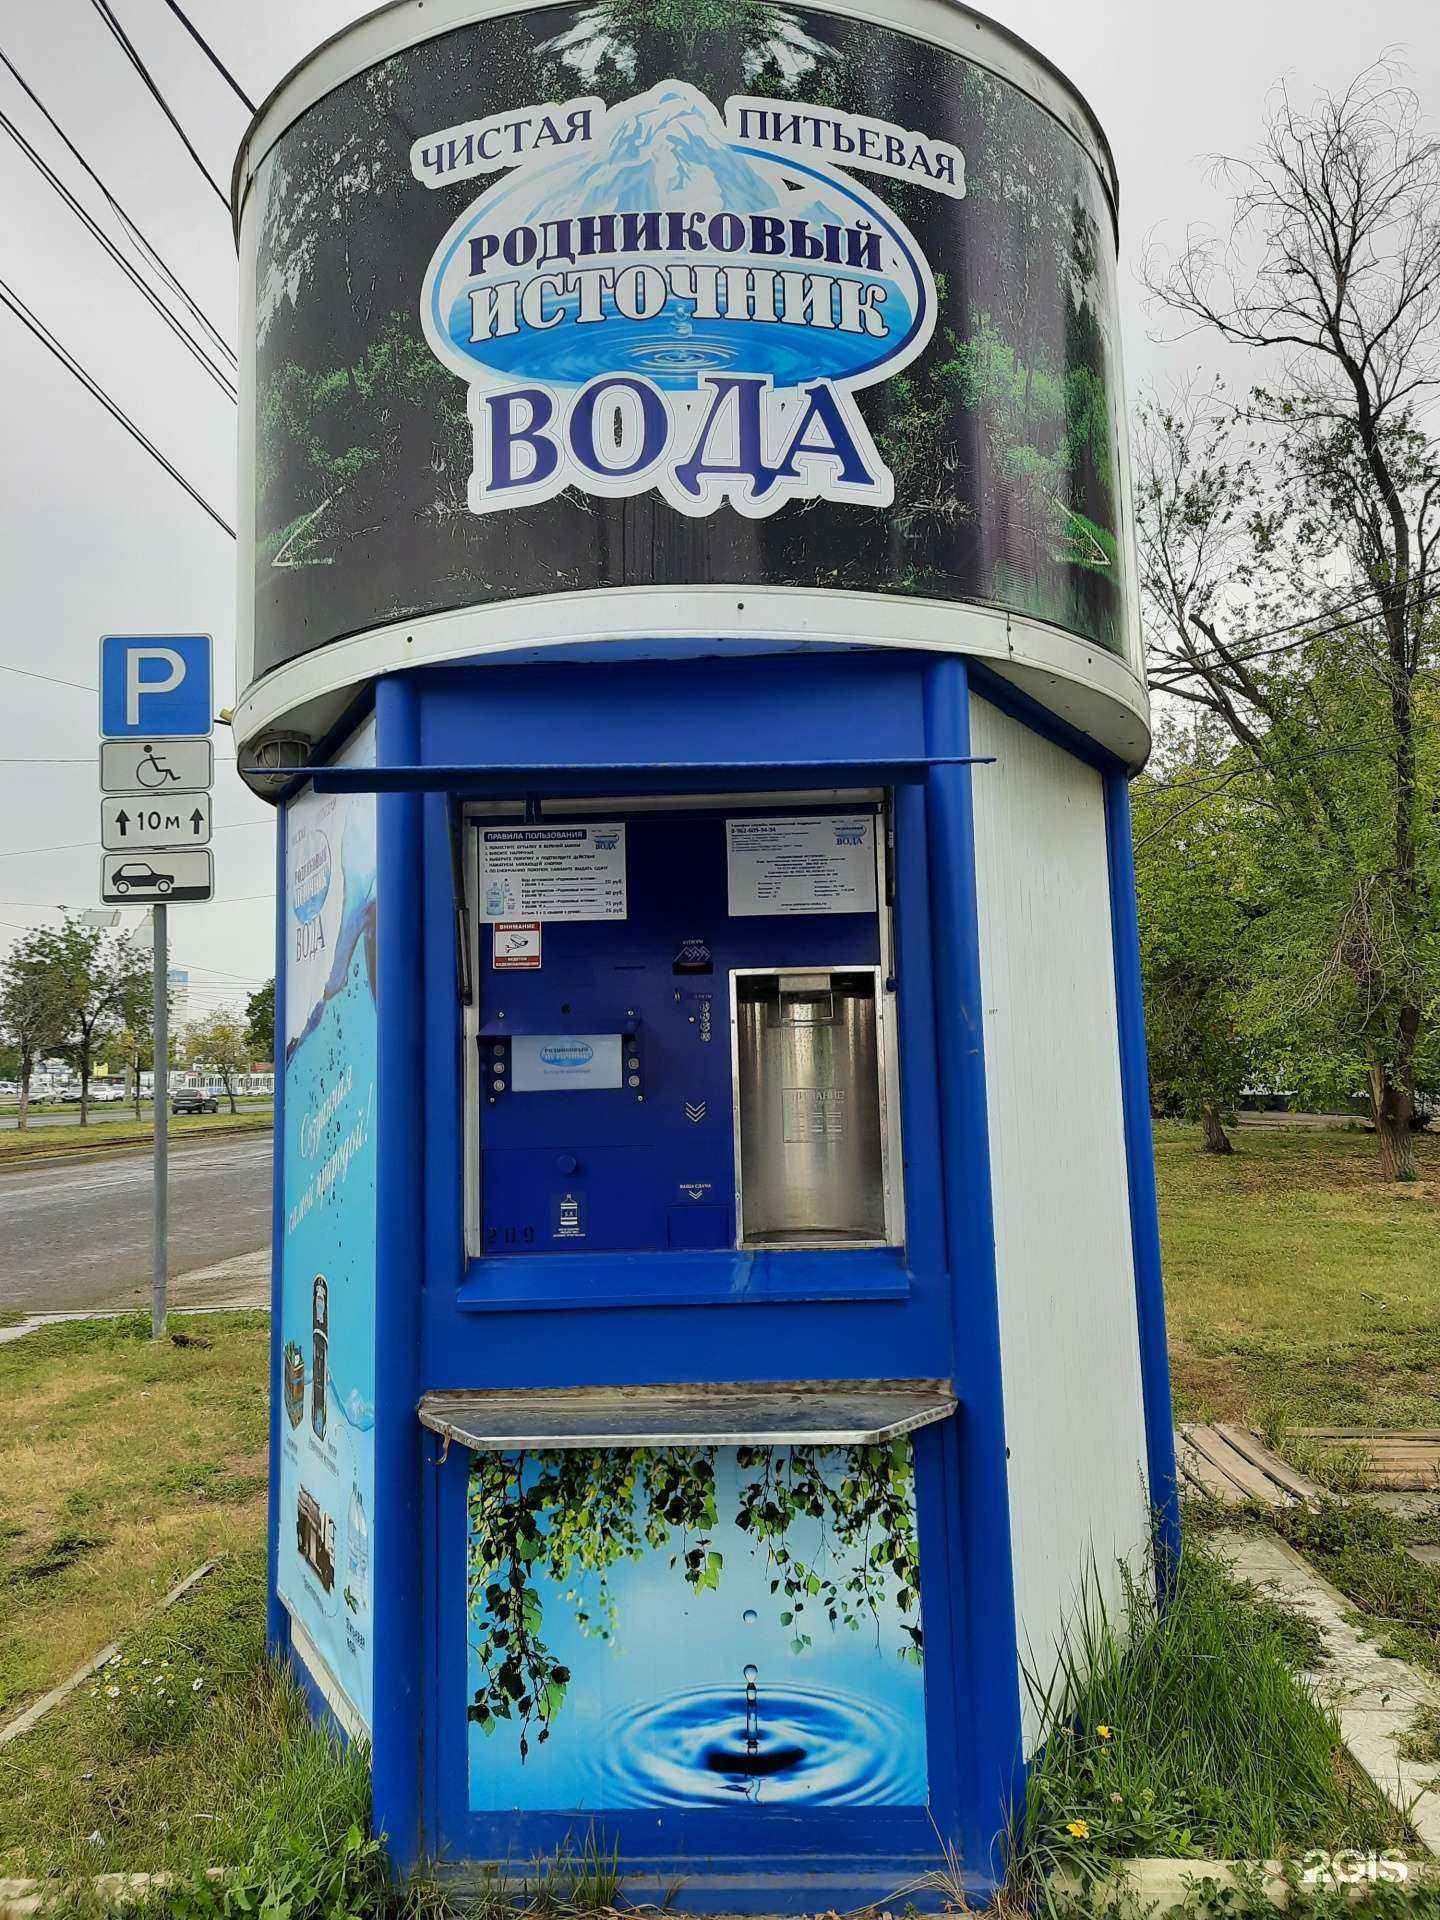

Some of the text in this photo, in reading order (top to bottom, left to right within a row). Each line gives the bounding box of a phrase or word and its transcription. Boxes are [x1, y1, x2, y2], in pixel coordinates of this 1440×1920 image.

[420, 108, 956, 186] ЧИСТАЯ ПИТЬЕВАЯ
[468, 211, 882, 276] РОДНИКОВЫЙ
[467, 264, 890, 344] ИСТОЧНИК
[484, 376, 876, 498] ВОДА
[487, 832, 524, 841] ПРАВИЛА
[525, 831, 583, 840] ПОЛЬЗОВАНИЯ
